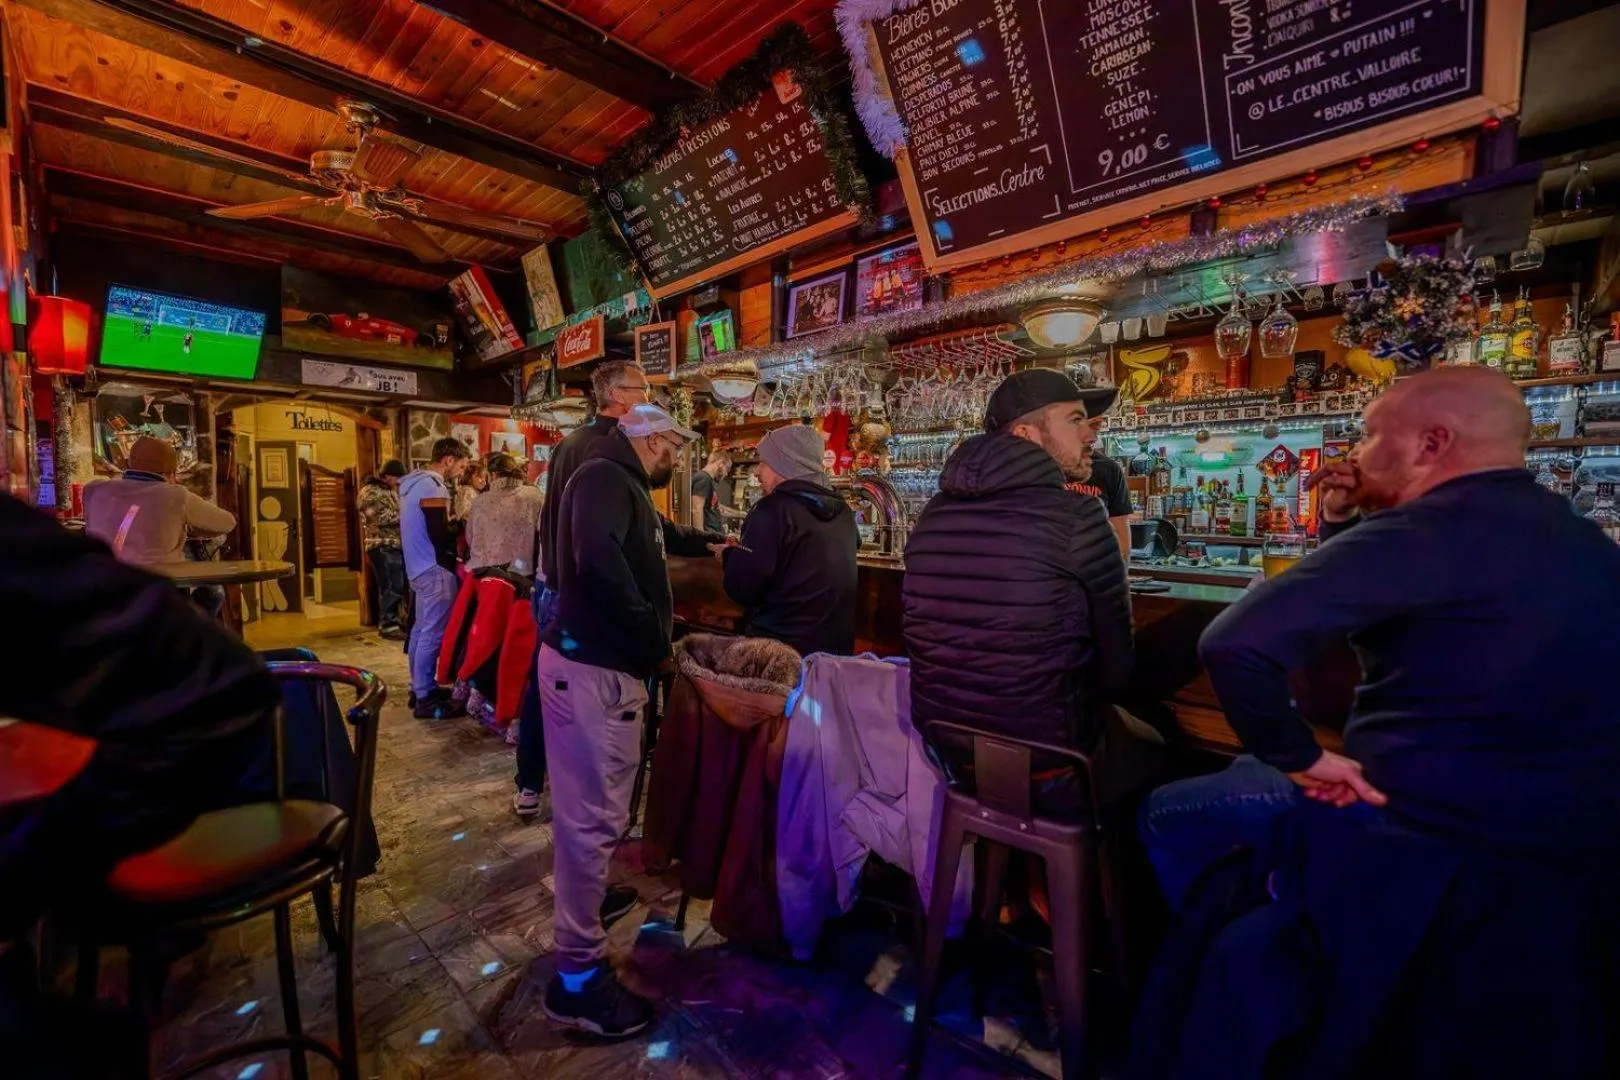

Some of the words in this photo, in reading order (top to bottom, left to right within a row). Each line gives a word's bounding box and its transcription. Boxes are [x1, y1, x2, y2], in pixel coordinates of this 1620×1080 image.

[1079, 5, 1154, 49] TENNESSEE
[1089, 0, 1142, 30] MOSCOW
[890, 30, 933, 61] HEINEKEN
[1091, 39, 1151, 76] CARIBBEAN
[1092, 27, 1145, 61] JAMAICAN
[1107, 61, 1140, 85] SUZE
[1236, 78, 1255, 95] ON
[1258, 64, 1292, 86] VOUS
[1294, 51, 1327, 75] AIME
[1343, 24, 1397, 57] PUTAIN
[1104, 89, 1151, 117] GENEPI
[1324, 96, 1365, 121] BISOUS
[1367, 82, 1410, 108] BISOUS
[1111, 105, 1150, 129] LEMON
[913, 127, 943, 147] DUVEL
[921, 165, 939, 181] BON
[375, 381, 392, 392] JB
[285, 411, 343, 432] Toilettes
